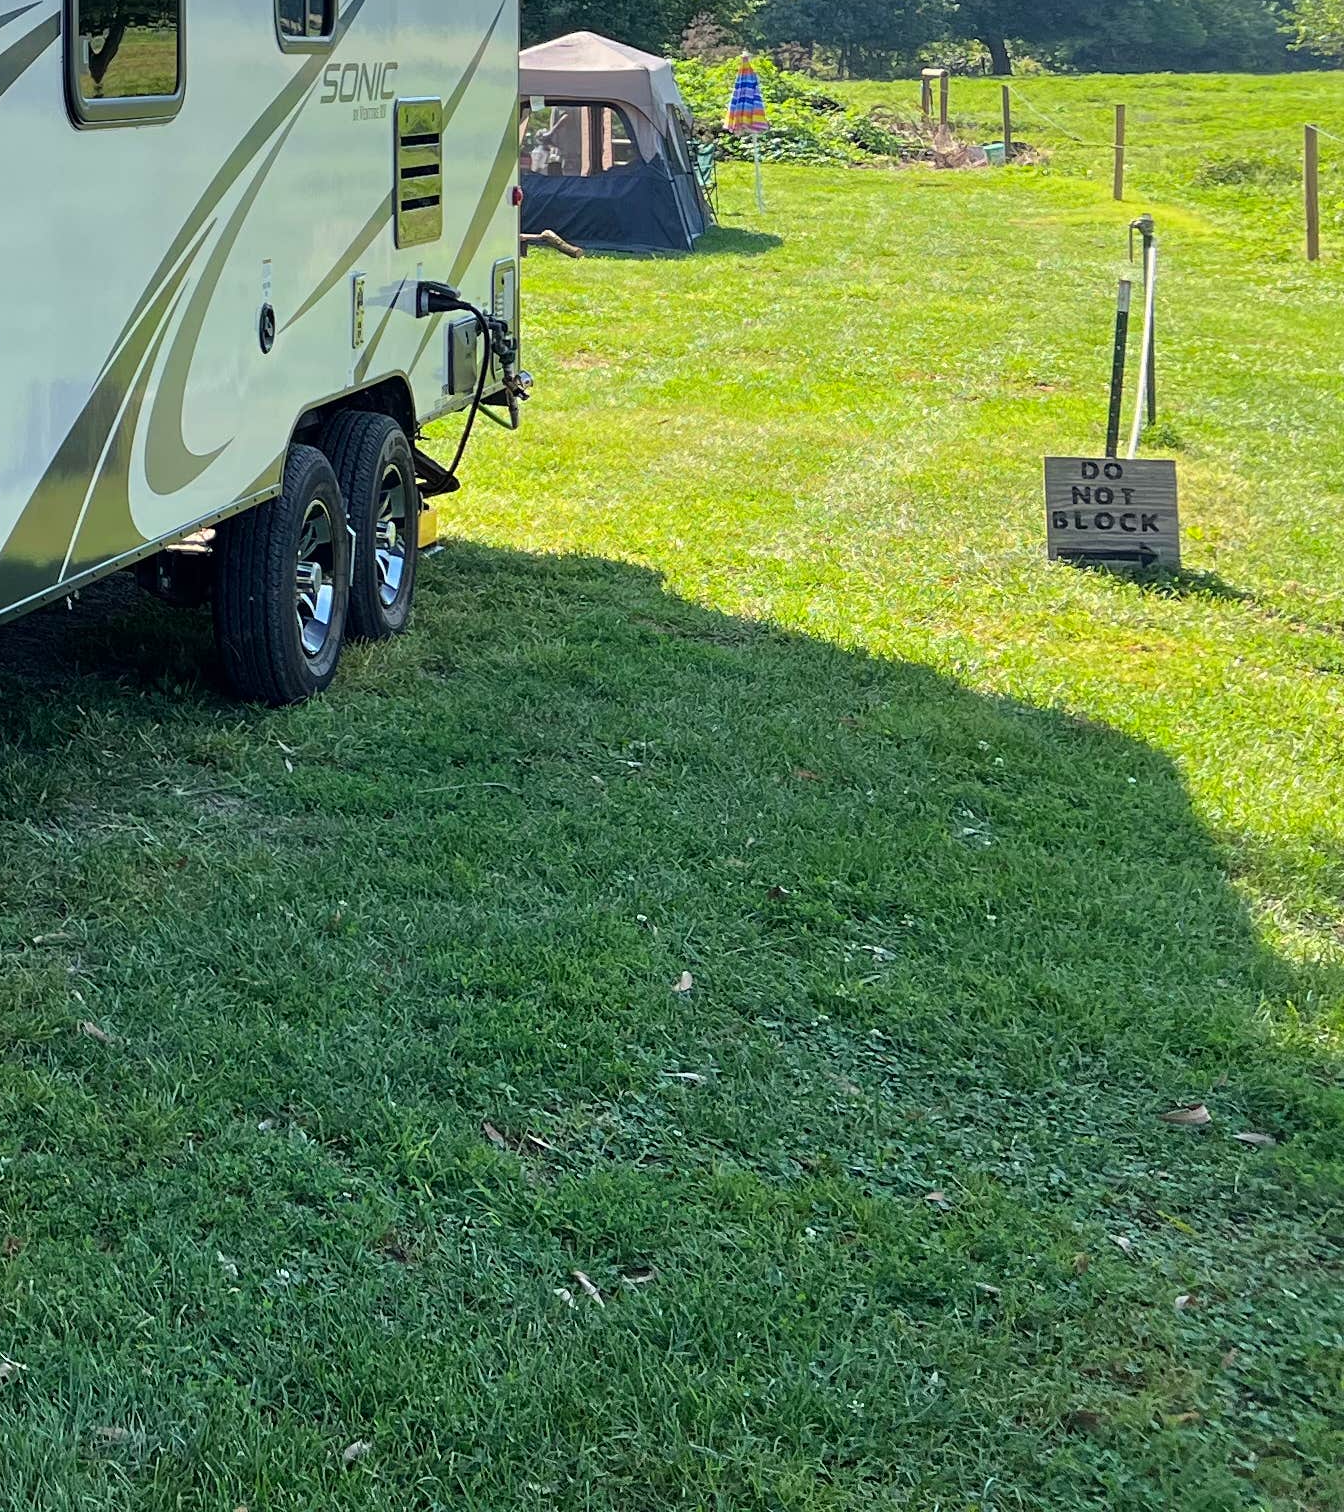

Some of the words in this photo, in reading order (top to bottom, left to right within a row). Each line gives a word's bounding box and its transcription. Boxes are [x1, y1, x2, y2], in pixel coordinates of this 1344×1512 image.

[320, 62, 398, 104] SONIC
[1081, 462, 1123, 480] DO
[1072, 486, 1136, 505] NOT
[1052, 511, 1160, 532] BLOCK
